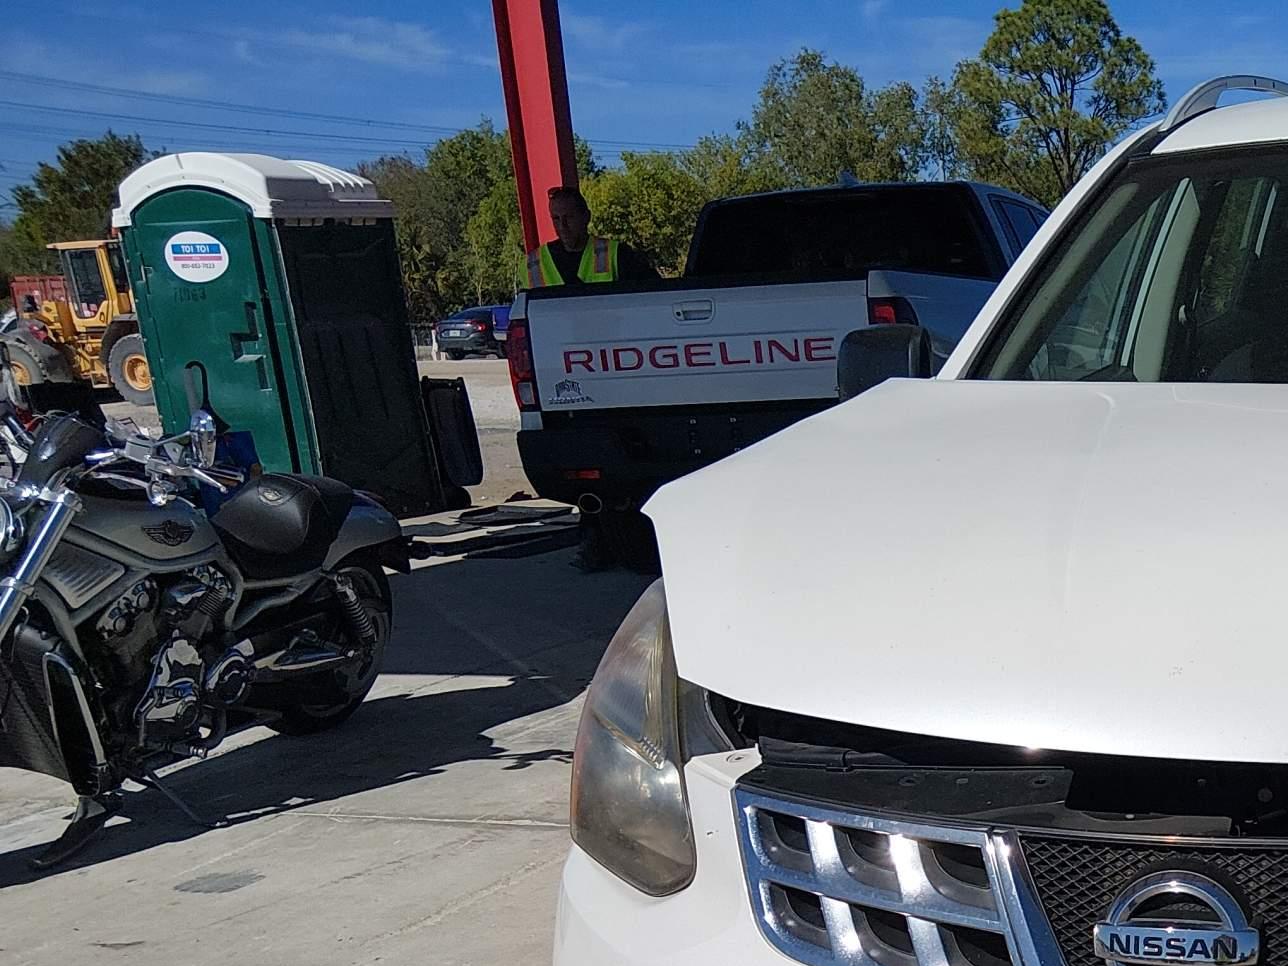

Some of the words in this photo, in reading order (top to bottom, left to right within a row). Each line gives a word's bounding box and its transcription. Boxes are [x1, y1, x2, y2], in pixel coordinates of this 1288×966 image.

[181, 245, 193, 253] TOI
[196, 245, 209, 253] TOI
[563, 337, 837, 374] RIDGELINE
[1109, 933, 1237, 959] NISSAN
